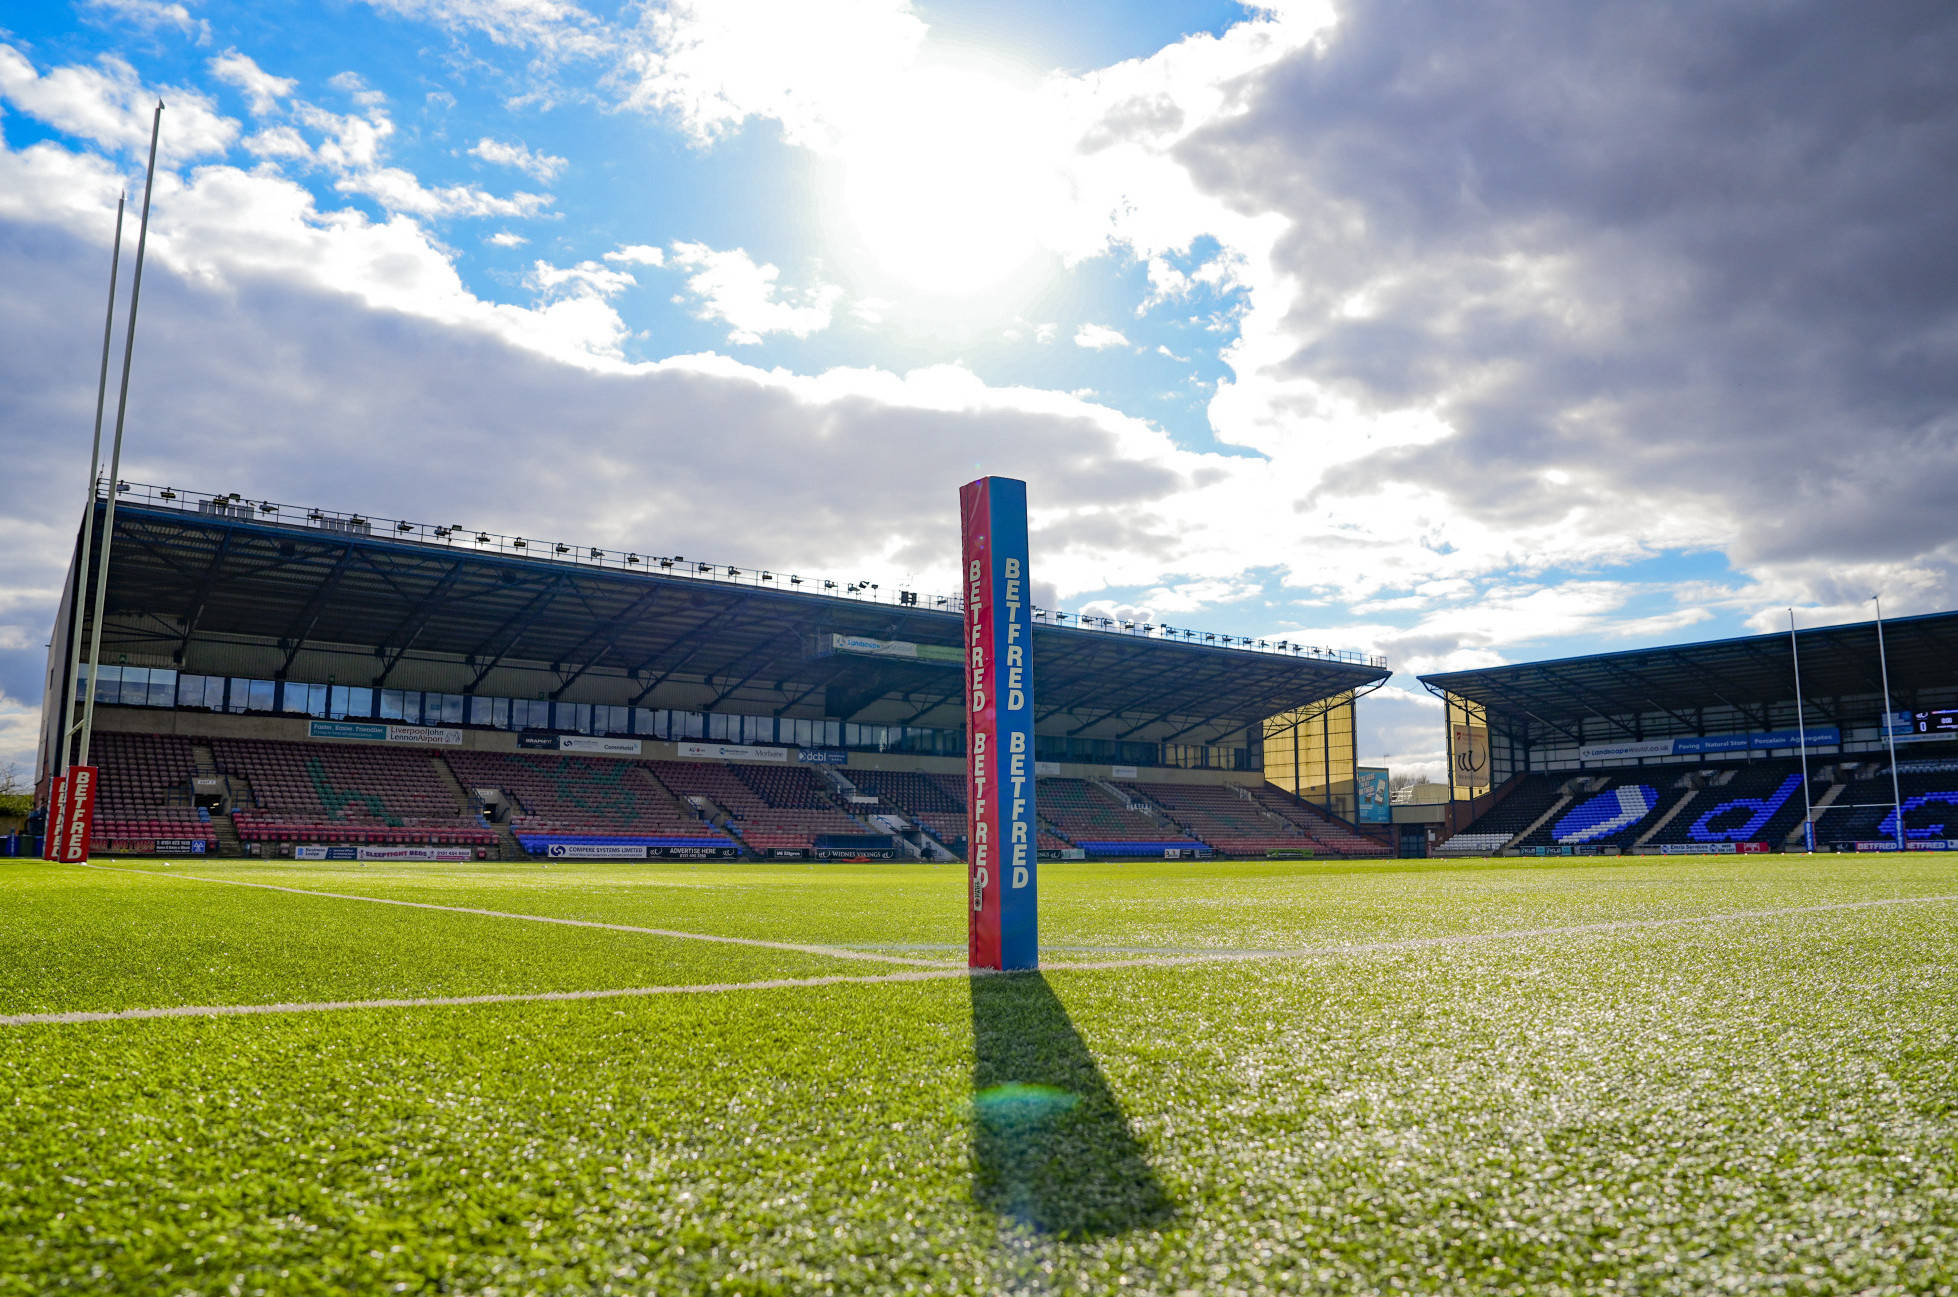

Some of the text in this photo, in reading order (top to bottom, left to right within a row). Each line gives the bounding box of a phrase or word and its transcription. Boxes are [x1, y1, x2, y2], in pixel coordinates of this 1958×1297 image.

[970, 560, 986, 712] BETFRED
[1005, 558, 1024, 710] BETFRED
[807, 752, 827, 762] dcbl
[1705, 740, 1729, 749] Natural
[1754, 735, 1786, 745] Porcelain
[1790, 733, 1833, 745] Agregates
[67, 771, 91, 859] BETFRED
[832, 850, 856, 858] WIDNES
[974, 733, 989, 888] BETFRED
[1010, 731, 1029, 888] BETFRED
